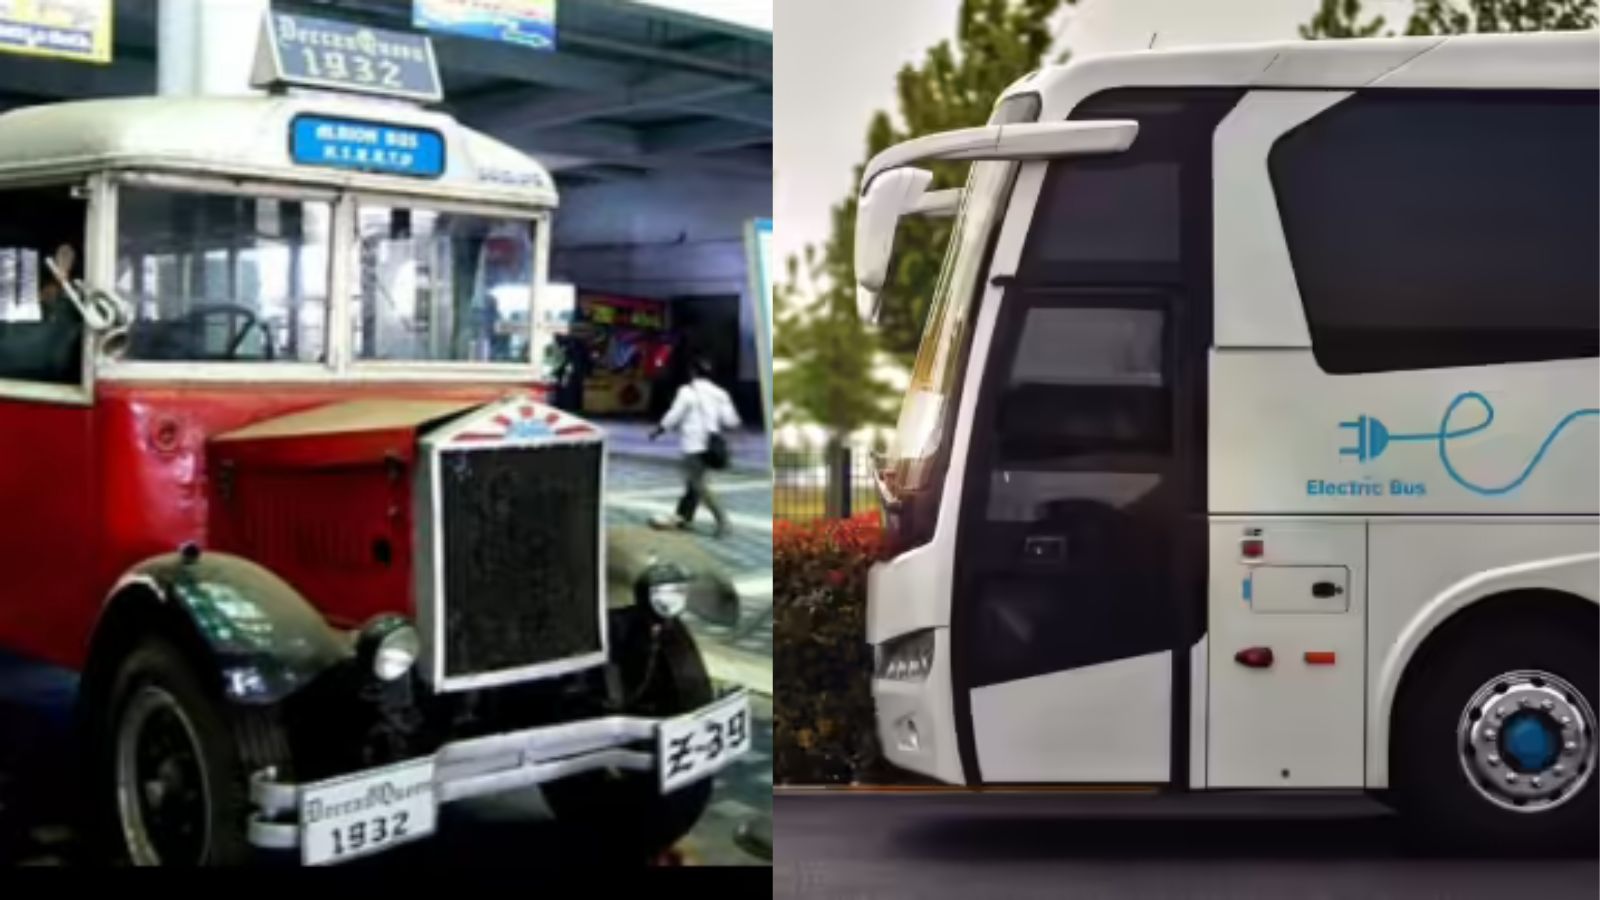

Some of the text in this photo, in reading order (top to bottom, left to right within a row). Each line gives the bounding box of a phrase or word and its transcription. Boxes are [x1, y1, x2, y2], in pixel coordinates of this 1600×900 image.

[301, 47, 402, 88] 1932
[1306, 479, 1427, 496] Electric Bus
[666, 710, 747, 778] Z-39
[331, 810, 409, 855] 1932
